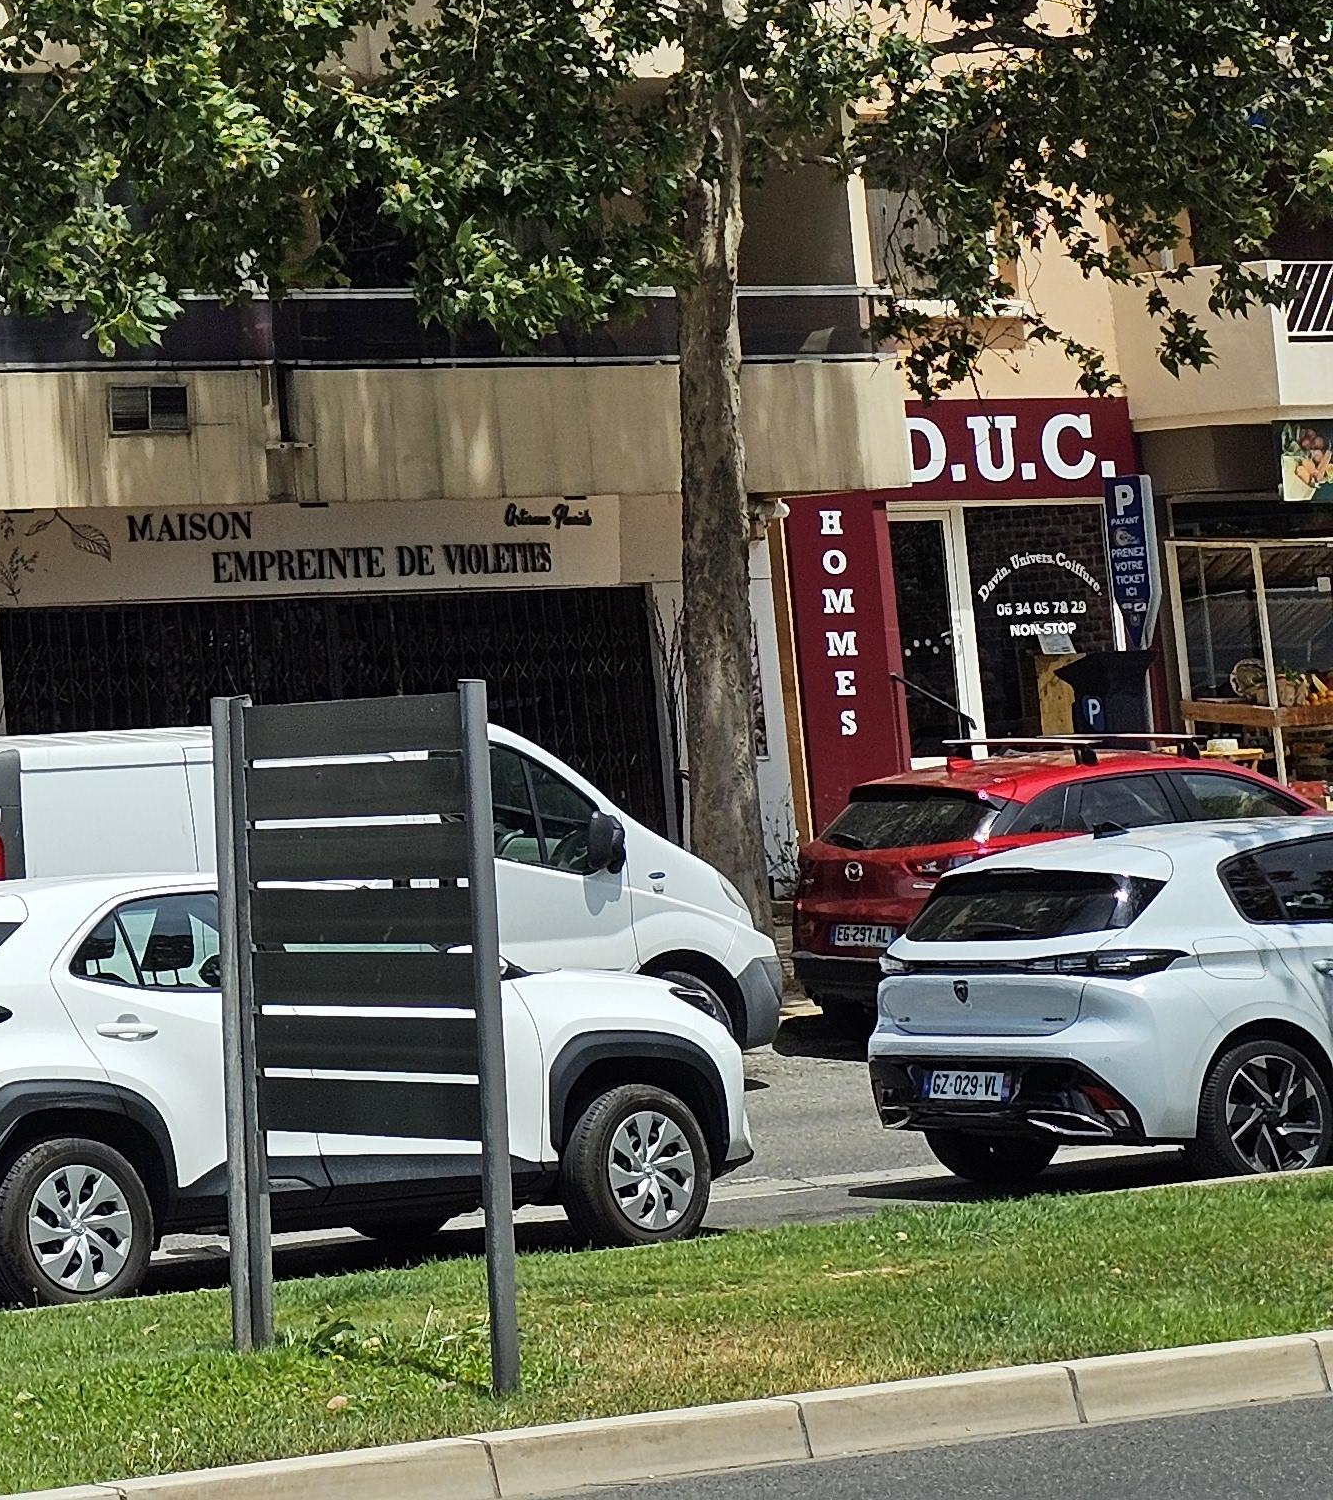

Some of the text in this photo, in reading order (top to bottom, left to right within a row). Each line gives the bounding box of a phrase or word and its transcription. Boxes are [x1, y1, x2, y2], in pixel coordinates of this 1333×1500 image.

[906, 414, 1116, 482] D.U.C.
[1114, 484, 1134, 516] P
[127, 510, 253, 542] MAISON
[1110, 516, 1140, 526] PAYANT
[1111, 546, 1145, 558] PRENEZ
[211, 546, 386, 584] EMPREINTE
[396, 544, 436, 578] DE
[1114, 560, 1144, 571] VOTRE
[1115, 574, 1145, 585] TICKET
[1125, 587, 1138, 597] ICI
[996, 600, 1087, 616] 06 34 05 78 29
[818, 510, 859, 736] HOMMES
[1009, 622, 1076, 637] NON-STOP
[1087, 698, 1101, 725] P
[837, 926, 889, 943] EG-297-AL
[932, 1074, 1000, 1097] GZ-029-VL
